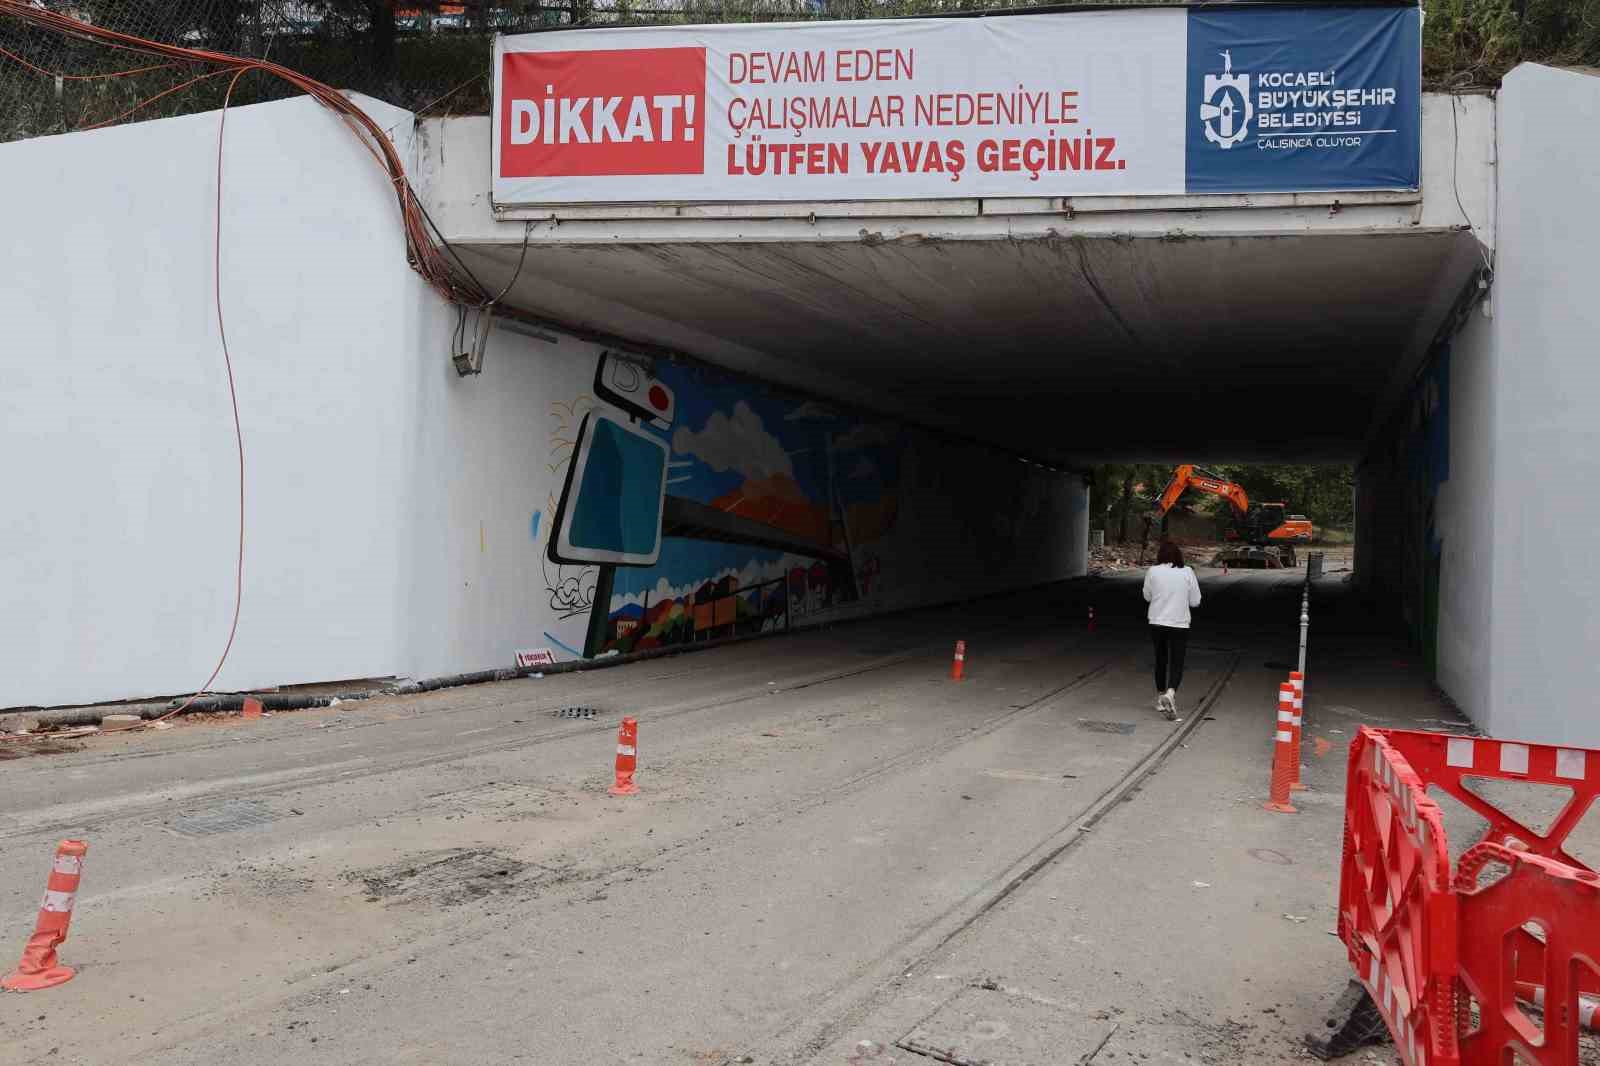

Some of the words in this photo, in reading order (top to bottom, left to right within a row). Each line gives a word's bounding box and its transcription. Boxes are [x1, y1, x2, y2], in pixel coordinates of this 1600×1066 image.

[729, 50, 826, 84] DEVAM
[836, 48, 914, 82] EDEN
[1258, 71, 1336, 87] KOCAELİ
[727, 95, 905, 138] ÇALIŞMALAR
[914, 84, 1079, 127] NEDENİYLE
[1258, 87, 1397, 110] BÜYÜKŞEHİR
[510, 84, 696, 145] DİKKAT!
[1258, 110, 1361, 128] BELEDİYESİ
[727, 134, 849, 176] LÜTFEN
[859, 139, 966, 182] YAVAŞ
[976, 128, 1127, 182] GEÇİNİZ.
[1316, 137, 1361, 148] OLUYOR
